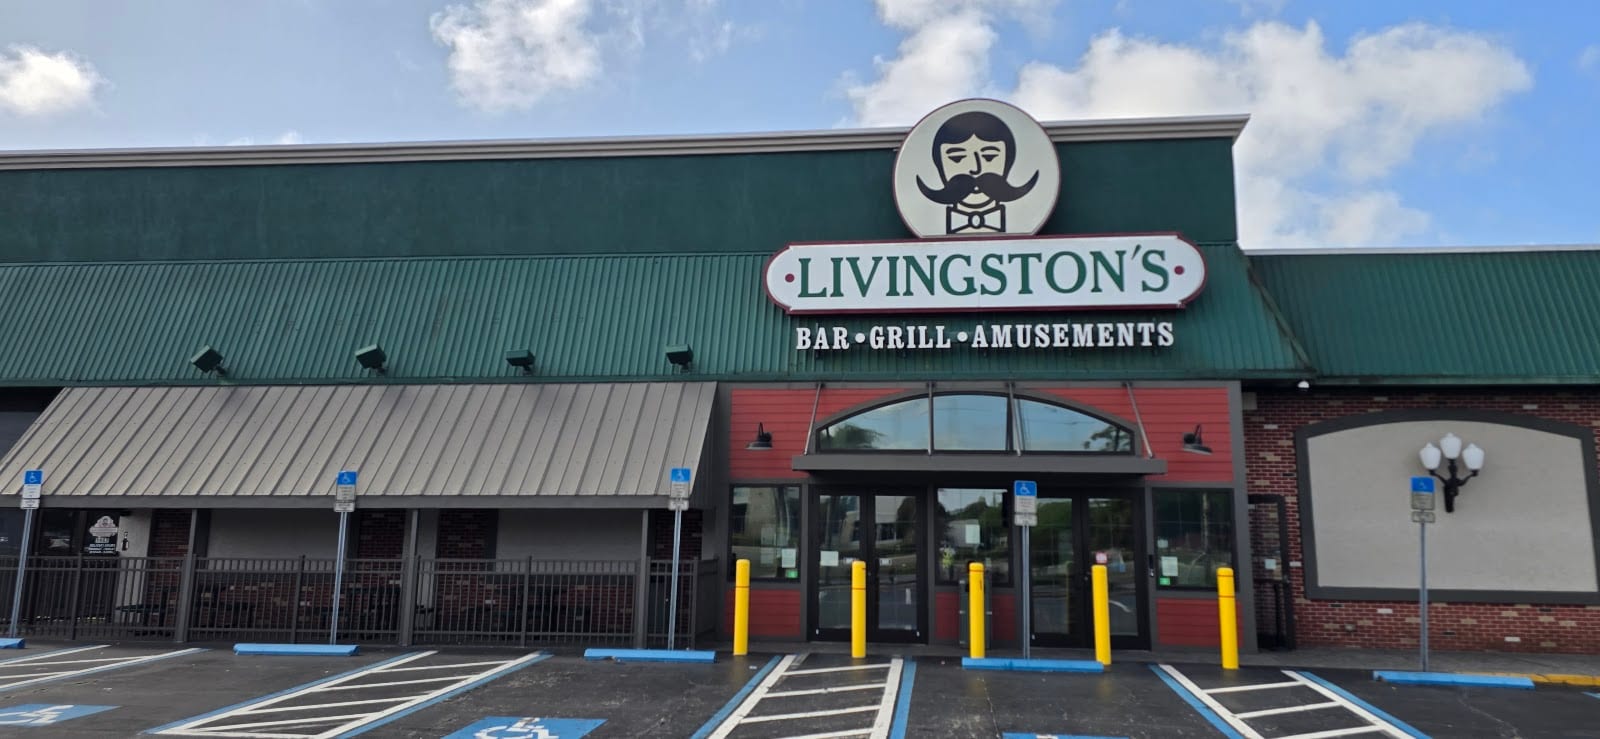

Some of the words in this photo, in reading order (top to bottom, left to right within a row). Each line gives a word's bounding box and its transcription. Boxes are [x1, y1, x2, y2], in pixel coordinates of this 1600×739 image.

[797, 244, 1170, 298] LIVINGSTON'S
[796, 326, 850, 350] BAR
[869, 325, 951, 349] GRILL
[971, 322, 1174, 348] AMUSEMENTS
